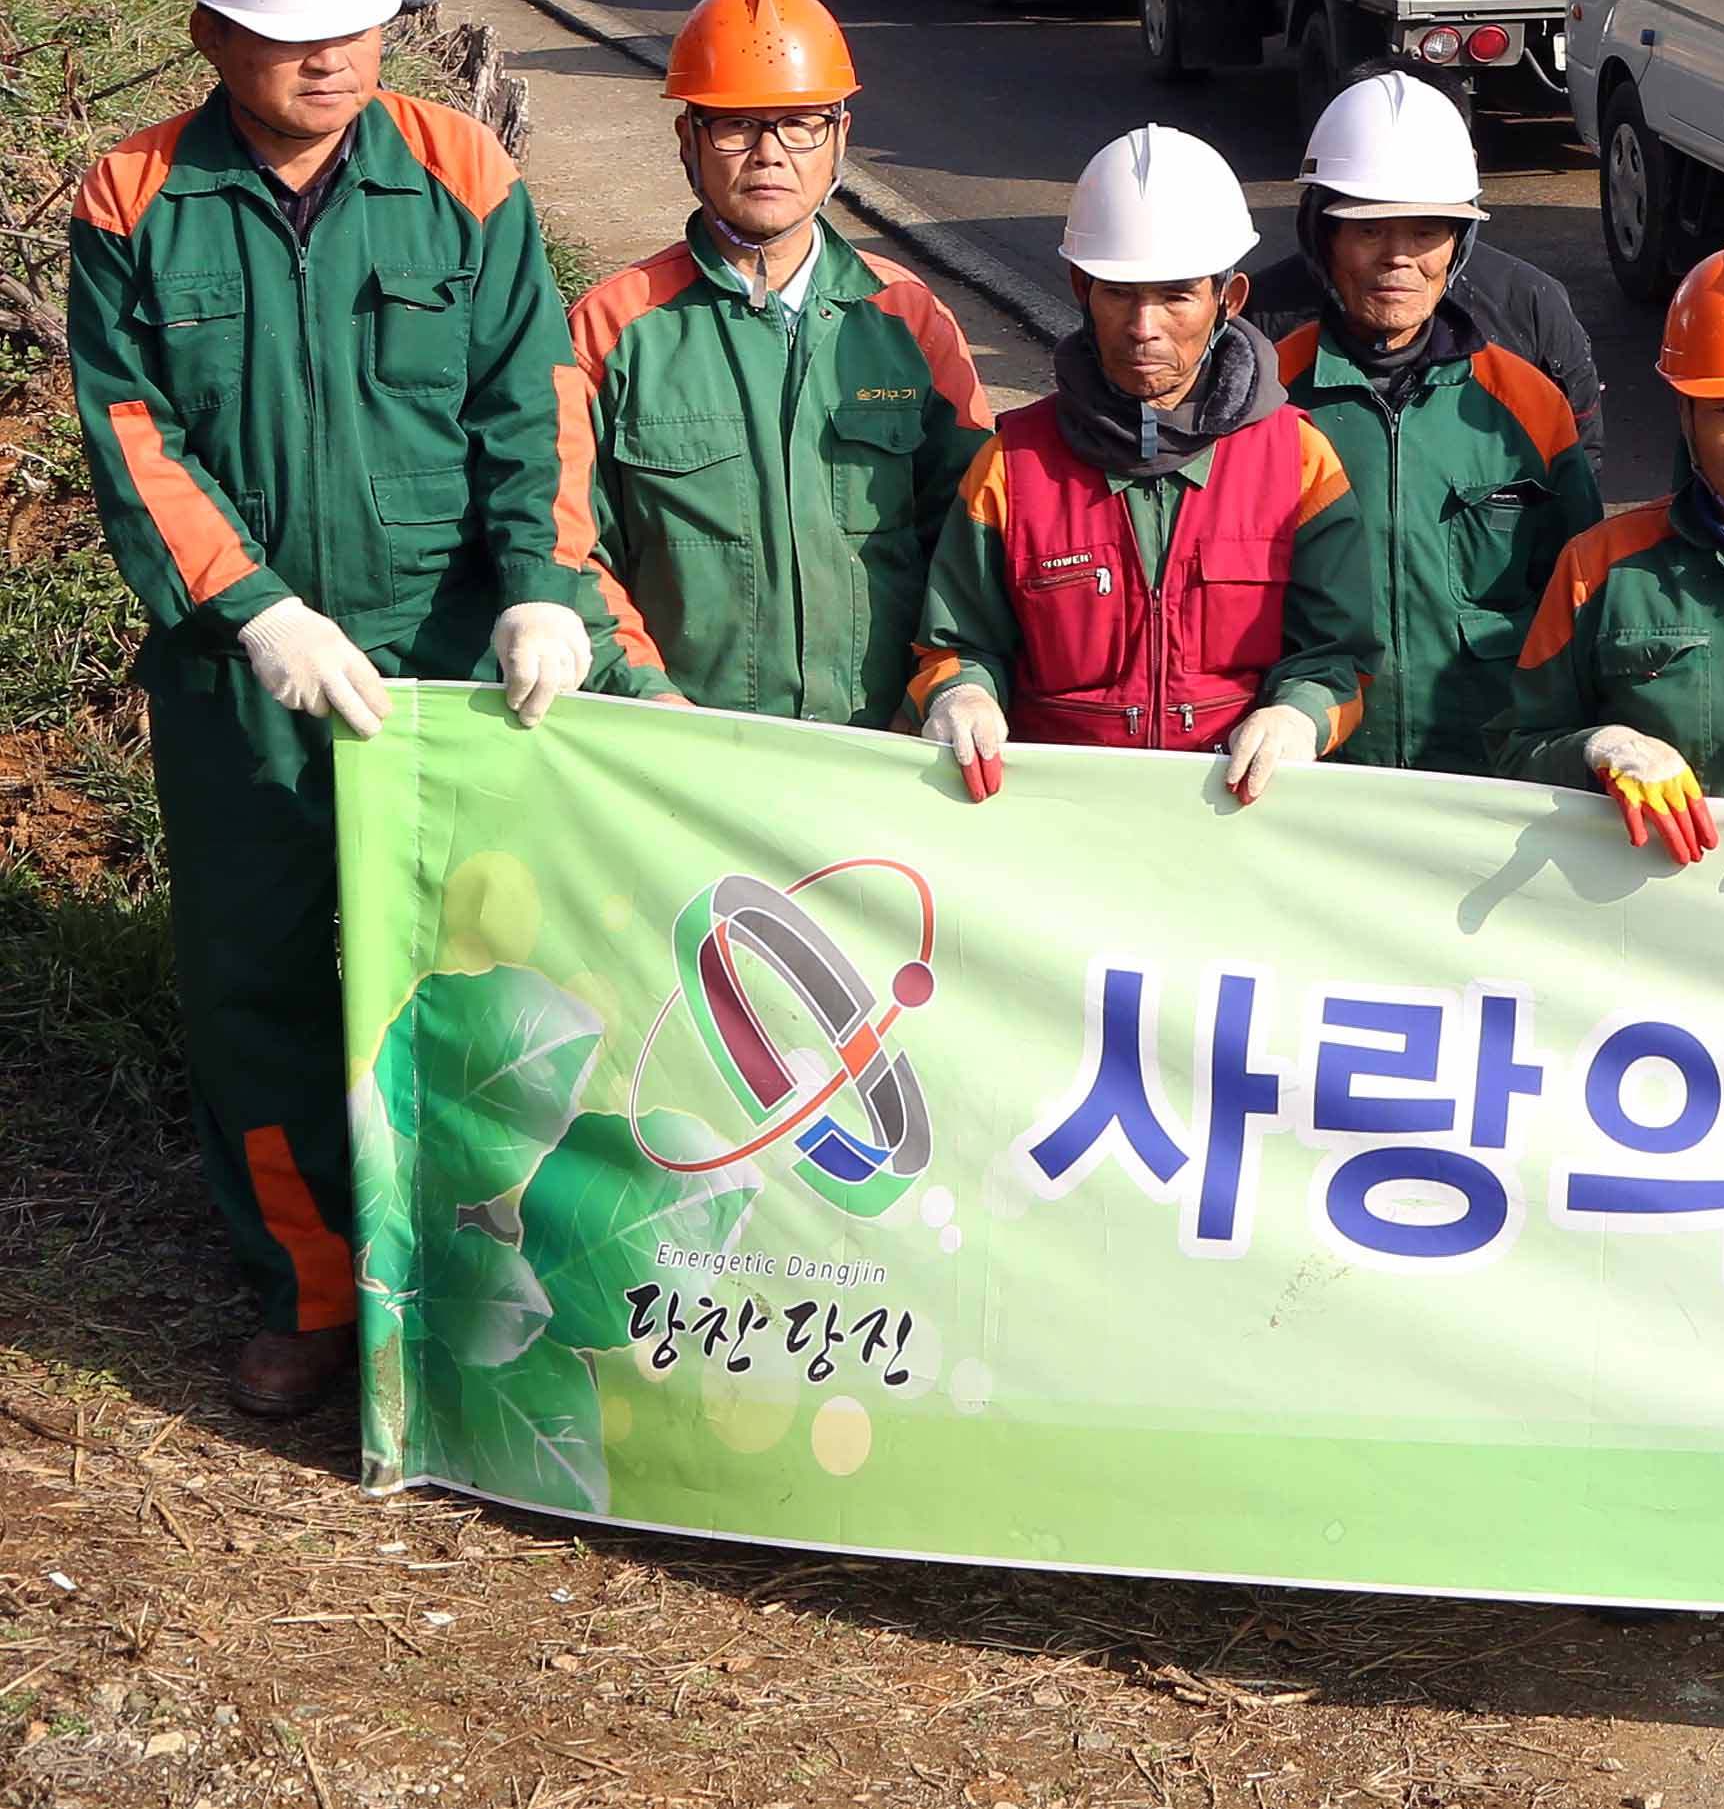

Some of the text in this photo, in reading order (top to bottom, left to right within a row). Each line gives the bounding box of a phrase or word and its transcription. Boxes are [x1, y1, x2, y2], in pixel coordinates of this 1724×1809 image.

[656, 1244, 887, 1287] Energetic Dangjin
[625, 1284, 914, 1386] 당찬 당진
